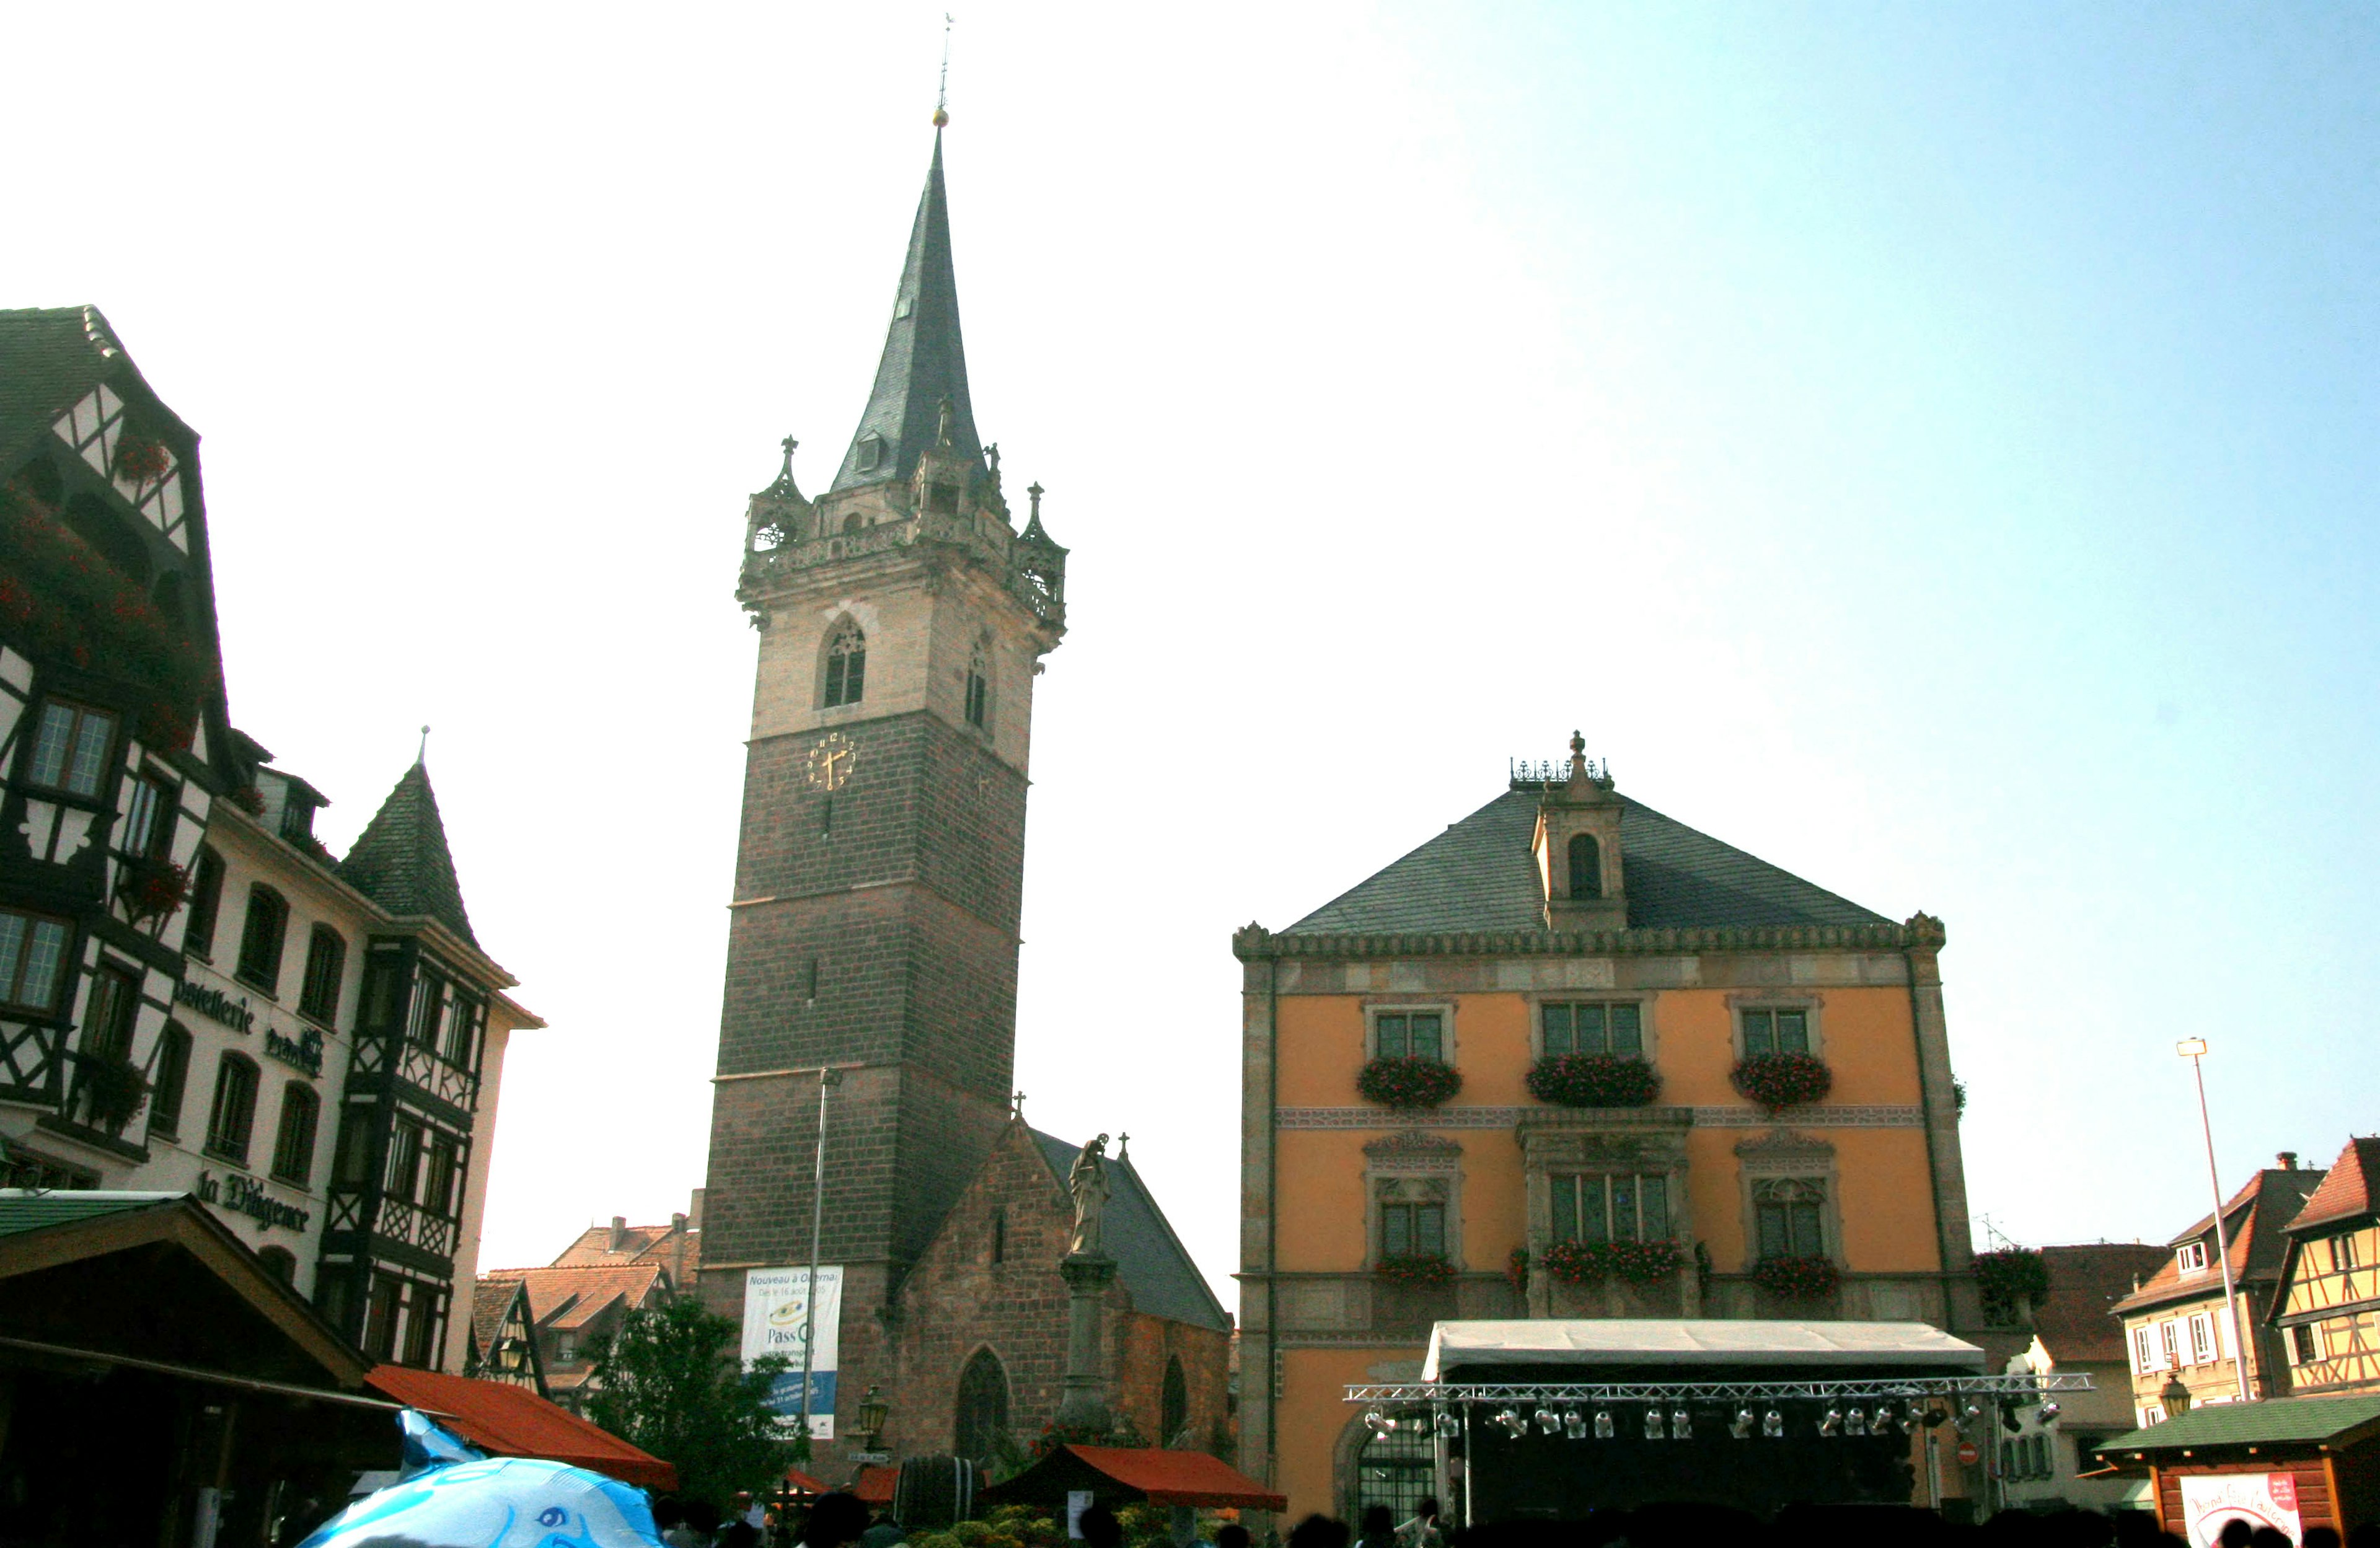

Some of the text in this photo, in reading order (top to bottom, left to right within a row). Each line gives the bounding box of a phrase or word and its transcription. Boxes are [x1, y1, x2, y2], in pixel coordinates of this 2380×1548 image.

[831, 732, 837, 742] 12
[843, 735, 845, 743] 1
[820, 739, 825, 747] 11
[849, 742, 854, 750] 2
[810, 749, 818, 758] 10
[852, 752, 856, 762] 3
[846, 765, 853, 775] 4
[809, 773, 814, 781] 8
[839, 776, 844, 785] 5
[816, 780, 822, 788] 7
[173, 982, 255, 1035] ostellerie
[749, 1273, 837, 1286] Nouveau à Oernai
[781, 1287, 789, 1296] 16
